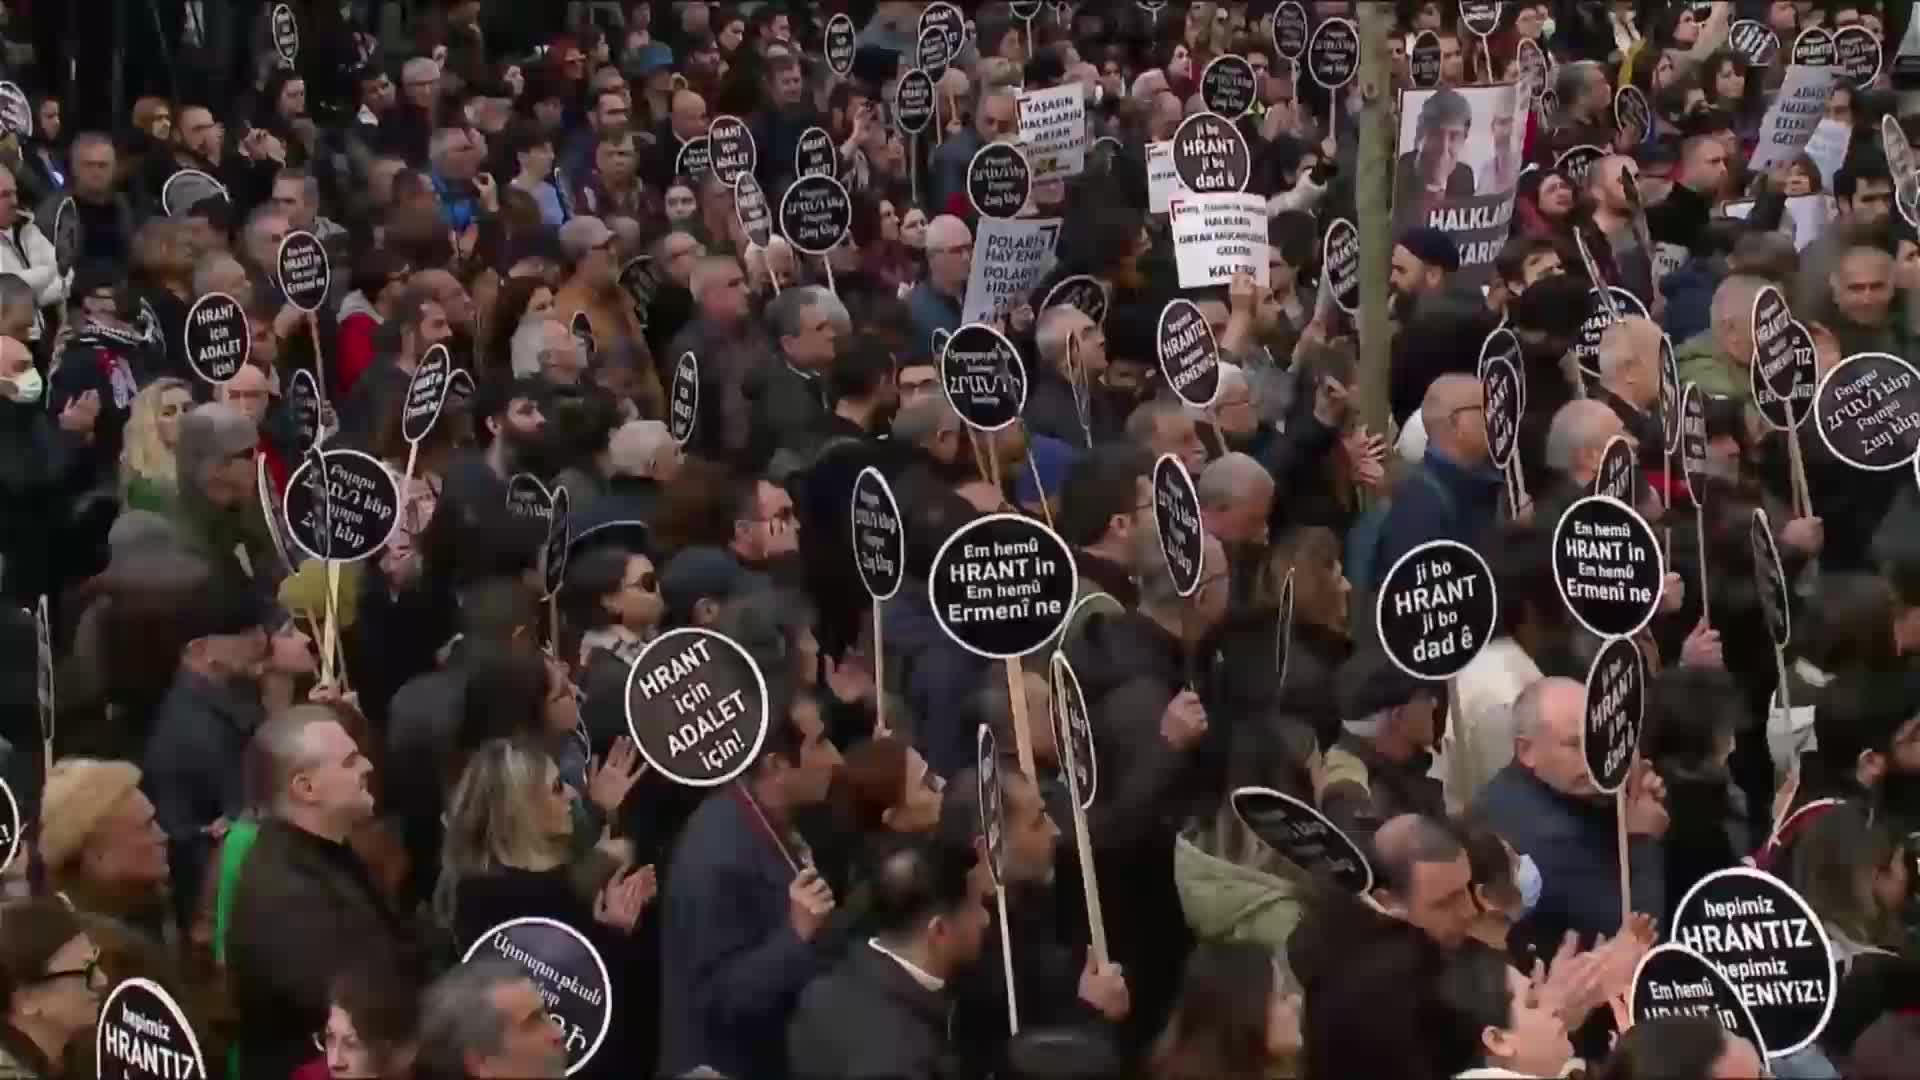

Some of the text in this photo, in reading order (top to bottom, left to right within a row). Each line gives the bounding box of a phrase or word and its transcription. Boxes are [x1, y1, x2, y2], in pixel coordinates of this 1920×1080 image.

[1182, 139, 1236, 157] HRANT
[196, 304, 235, 326] HRANT
[200, 339, 240, 361] ADALET
[1574, 520, 1631, 537] Em hemû
[964, 536, 1039, 559] Em hemû
[1565, 538, 1645, 563] HRANT in
[950, 556, 1056, 583] HRANT in
[1415, 560, 1452, 586] ji bo
[1578, 561, 1634, 580] Em hemû
[967, 579, 1041, 599] Em hemû
[1394, 574, 1478, 617] HRANT
[1566, 577, 1652, 603] Ermenî ne
[948, 598, 1062, 623] Ermenî ne
[1422, 610, 1458, 636] ji bo
[1413, 624, 1473, 662] dad ê
[638, 637, 712, 700] HRANT
[671, 681, 712, 715] için
[1590, 664, 1633, 733] HRANT
[667, 689, 746, 758] ADALET
[698, 727, 746, 772] için!
[1704, 895, 1776, 920] hepimiz
[1682, 918, 1813, 953] HRANTIZ
[1648, 976, 1714, 1000] Em hemû
[122, 1001, 171, 1041] hepimiz
[1715, 1004, 1737, 1030] in
[105, 1022, 194, 1080] HRANTIZ
